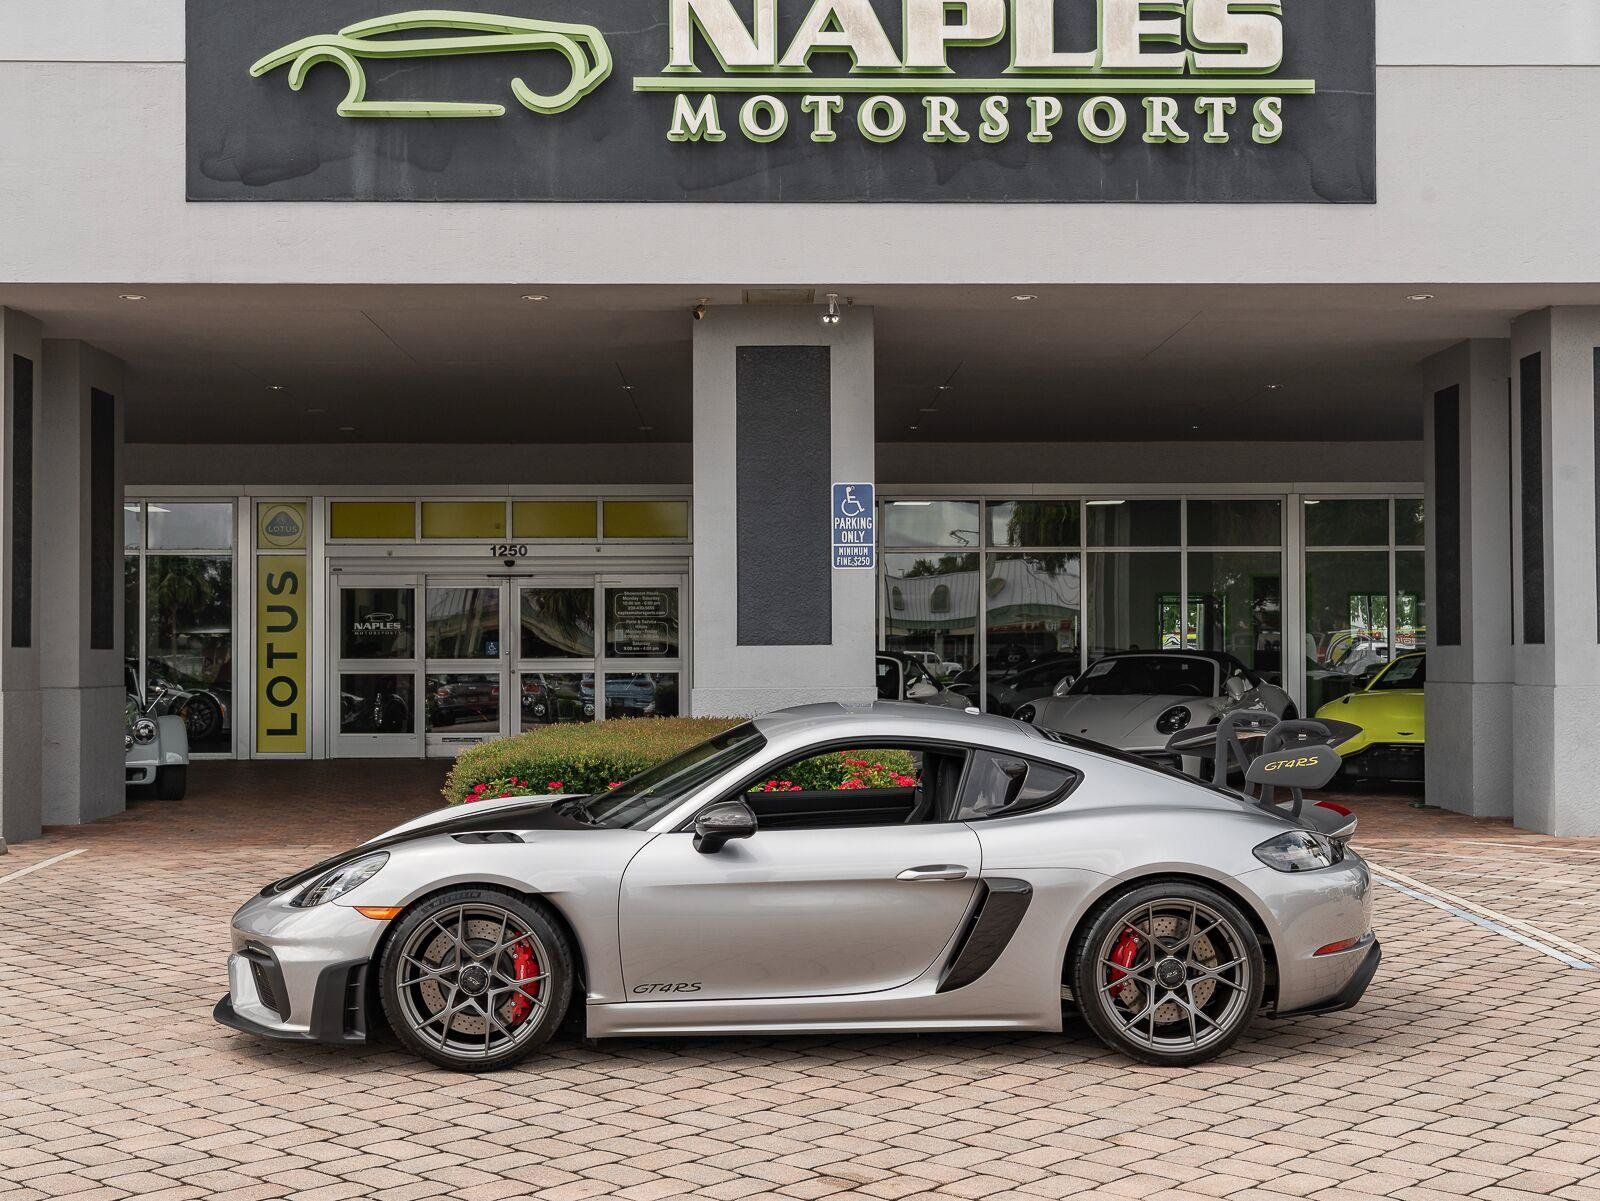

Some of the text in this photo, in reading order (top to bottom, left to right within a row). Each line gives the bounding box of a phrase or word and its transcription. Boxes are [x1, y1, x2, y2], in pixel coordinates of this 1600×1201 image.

[661, 0, 1284, 74] NAPLES
[666, 93, 1284, 144] MOTORSPORTS
[834, 517, 873, 530] PARKING
[841, 530, 865, 543] ONLY
[490, 544, 528, 557] 1250
[838, 546, 868, 556] MINIMUM
[836, 556, 870, 567] FINE $250
[353, 622, 401, 630] NAPLES
[266, 570, 299, 736] LOTUS
[1264, 756, 1318, 771] GT4RS
[632, 982, 702, 994] GT4RS
